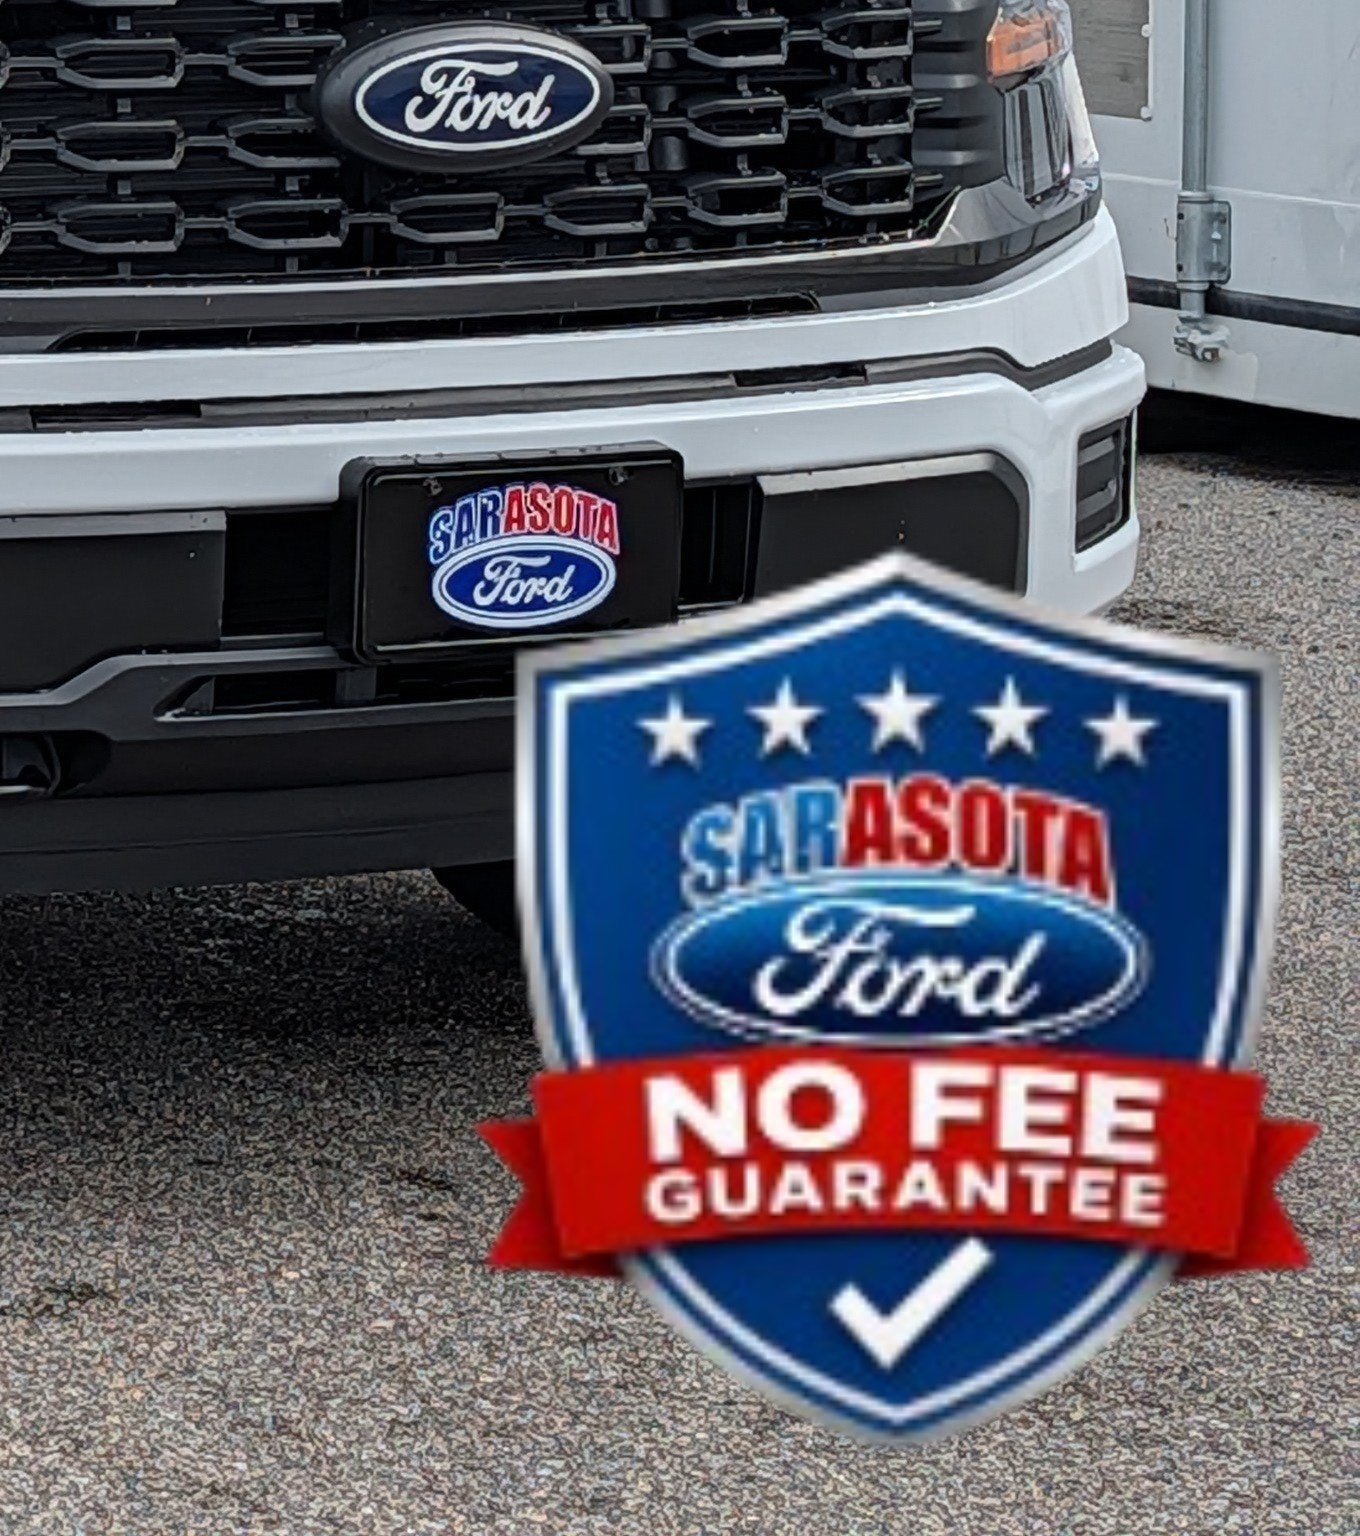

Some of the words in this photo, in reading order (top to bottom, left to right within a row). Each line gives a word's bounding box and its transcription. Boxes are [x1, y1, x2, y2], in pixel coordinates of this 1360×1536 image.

[404, 58, 556, 133] Ford
[429, 481, 621, 565] SARASOTA
[472, 555, 577, 606] Ford
